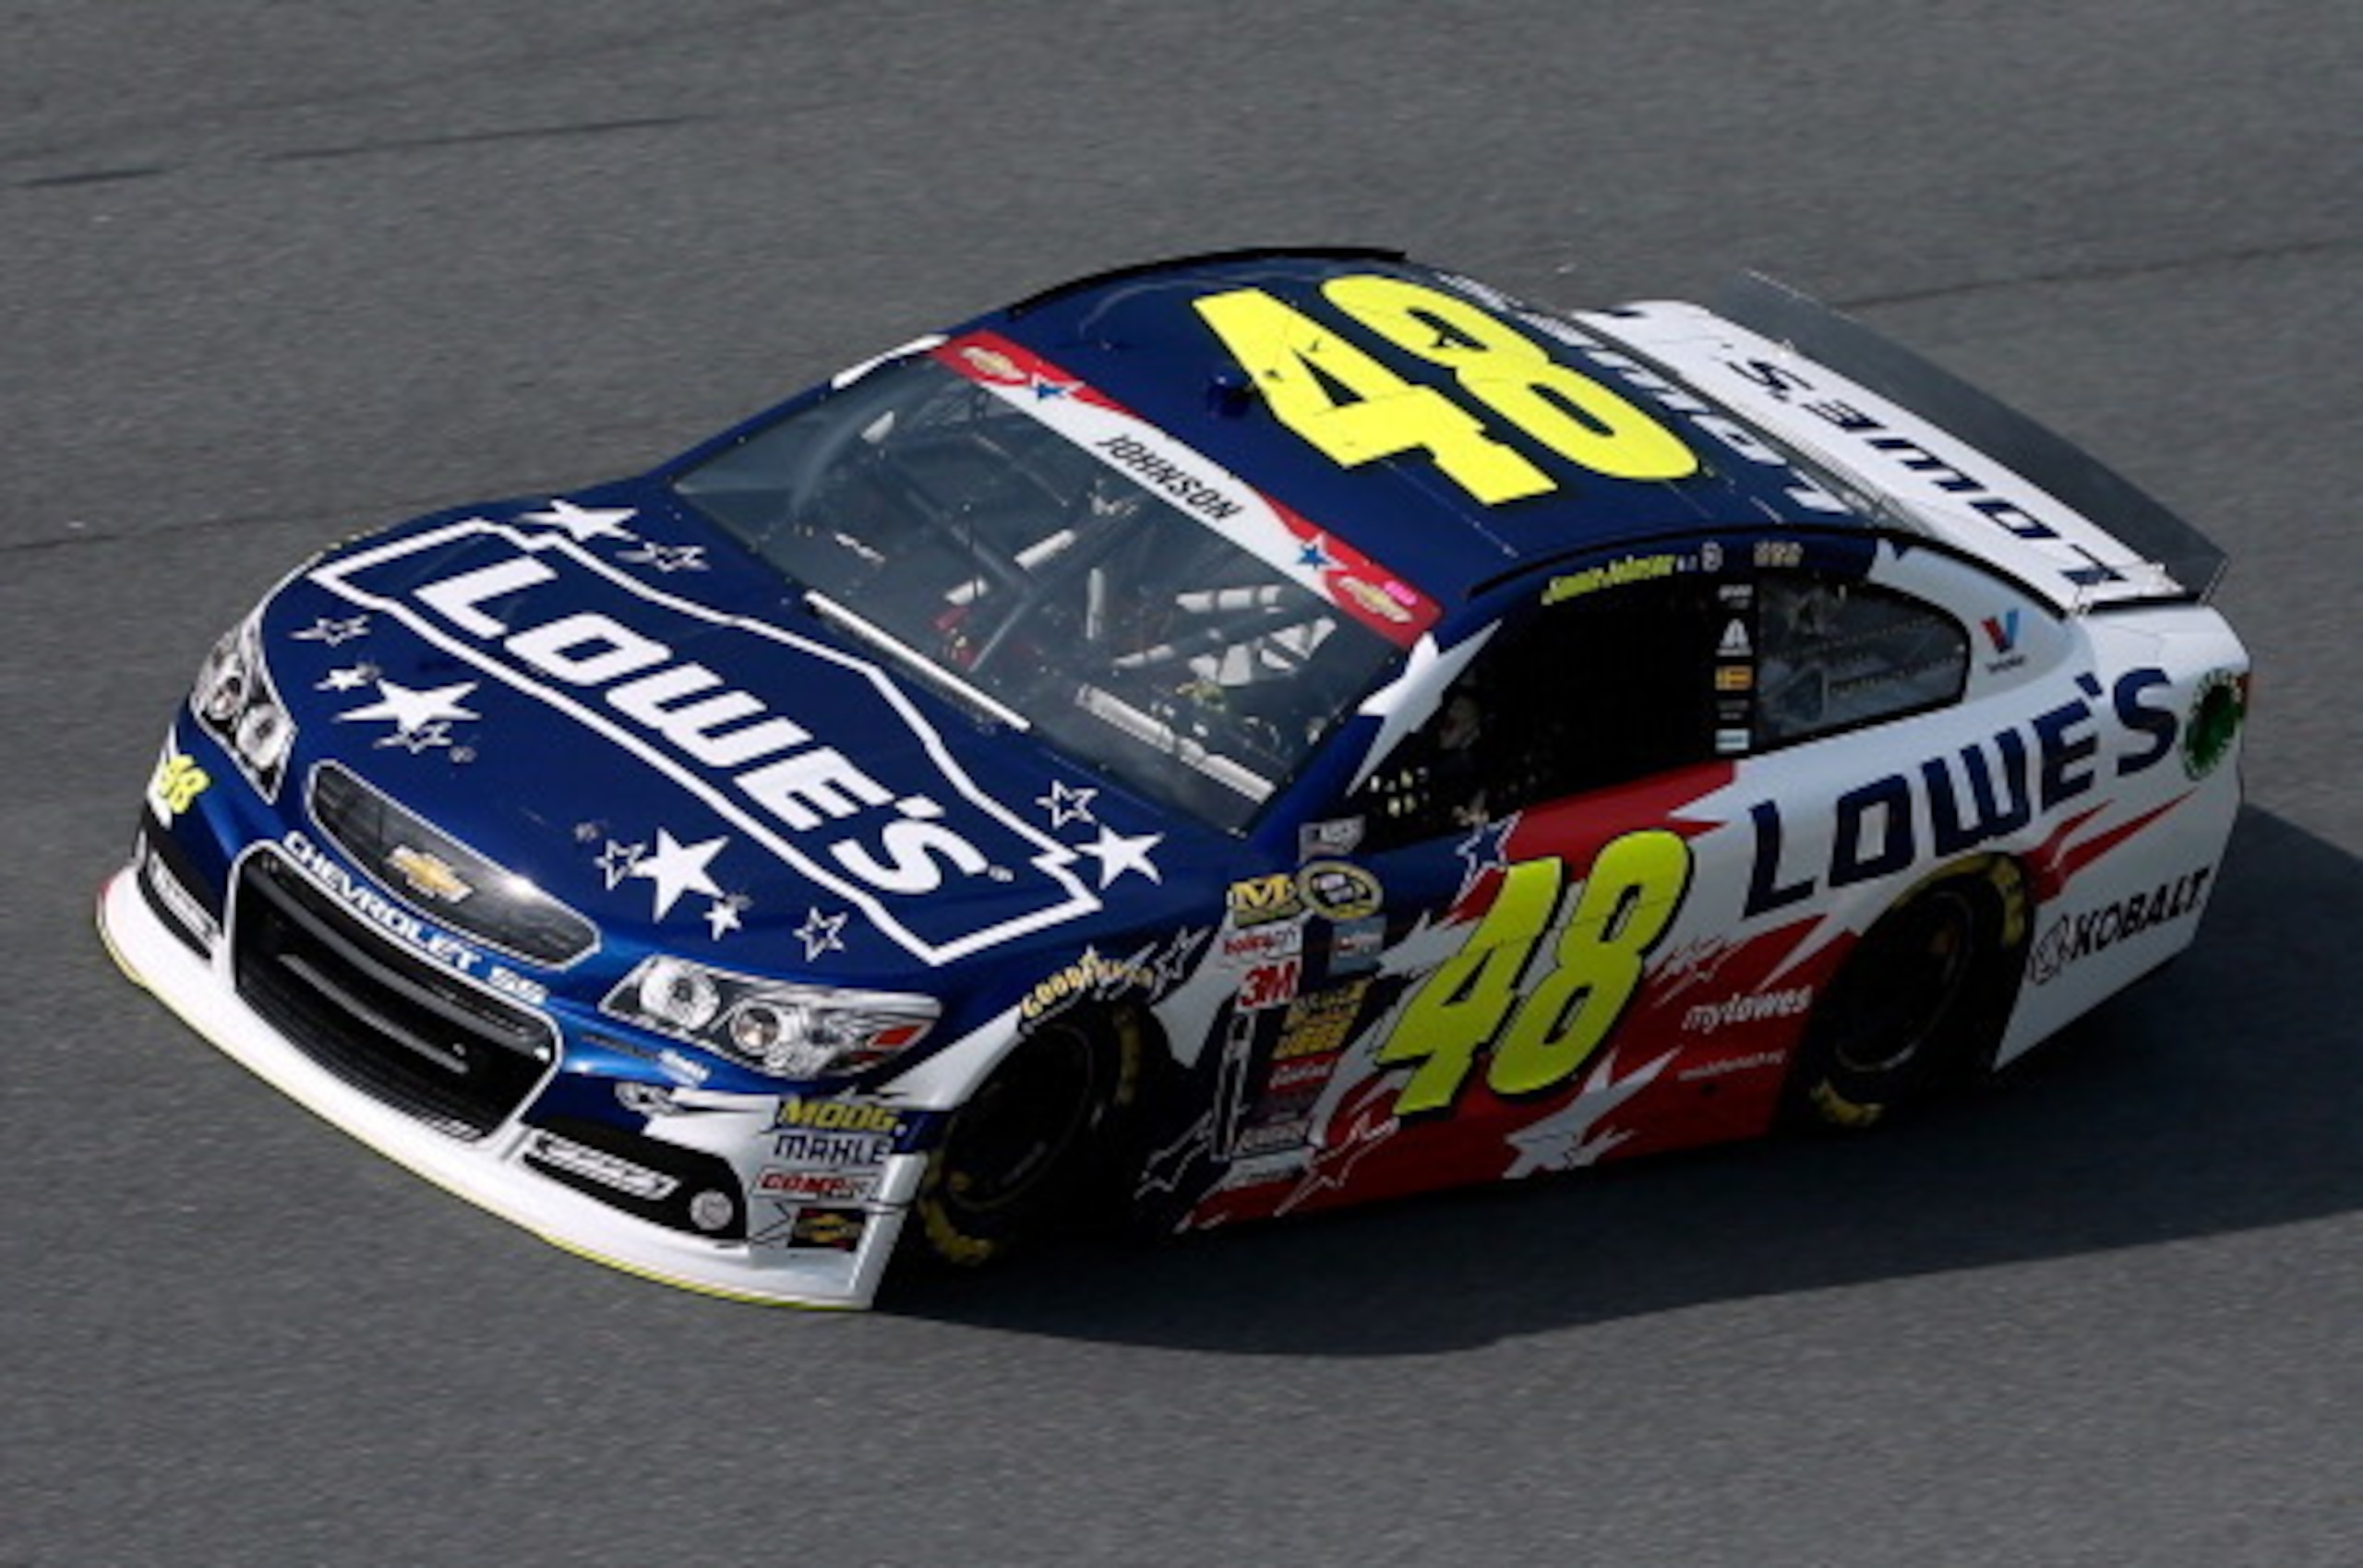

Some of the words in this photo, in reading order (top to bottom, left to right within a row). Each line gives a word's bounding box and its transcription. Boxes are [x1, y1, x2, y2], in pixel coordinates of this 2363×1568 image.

[1097, 434, 1244, 521] JOHNSON
[1192, 275, 1700, 505] 48
[412, 555, 986, 894] LOWE'S
[1744, 666, 2178, 919] LOWE'S
[282, 831, 481, 970] CHEVROLET
[1240, 961, 1299, 1008] 3M
[1373, 829, 1687, 1118] 48
[774, 1135, 893, 1165] MAHLE
